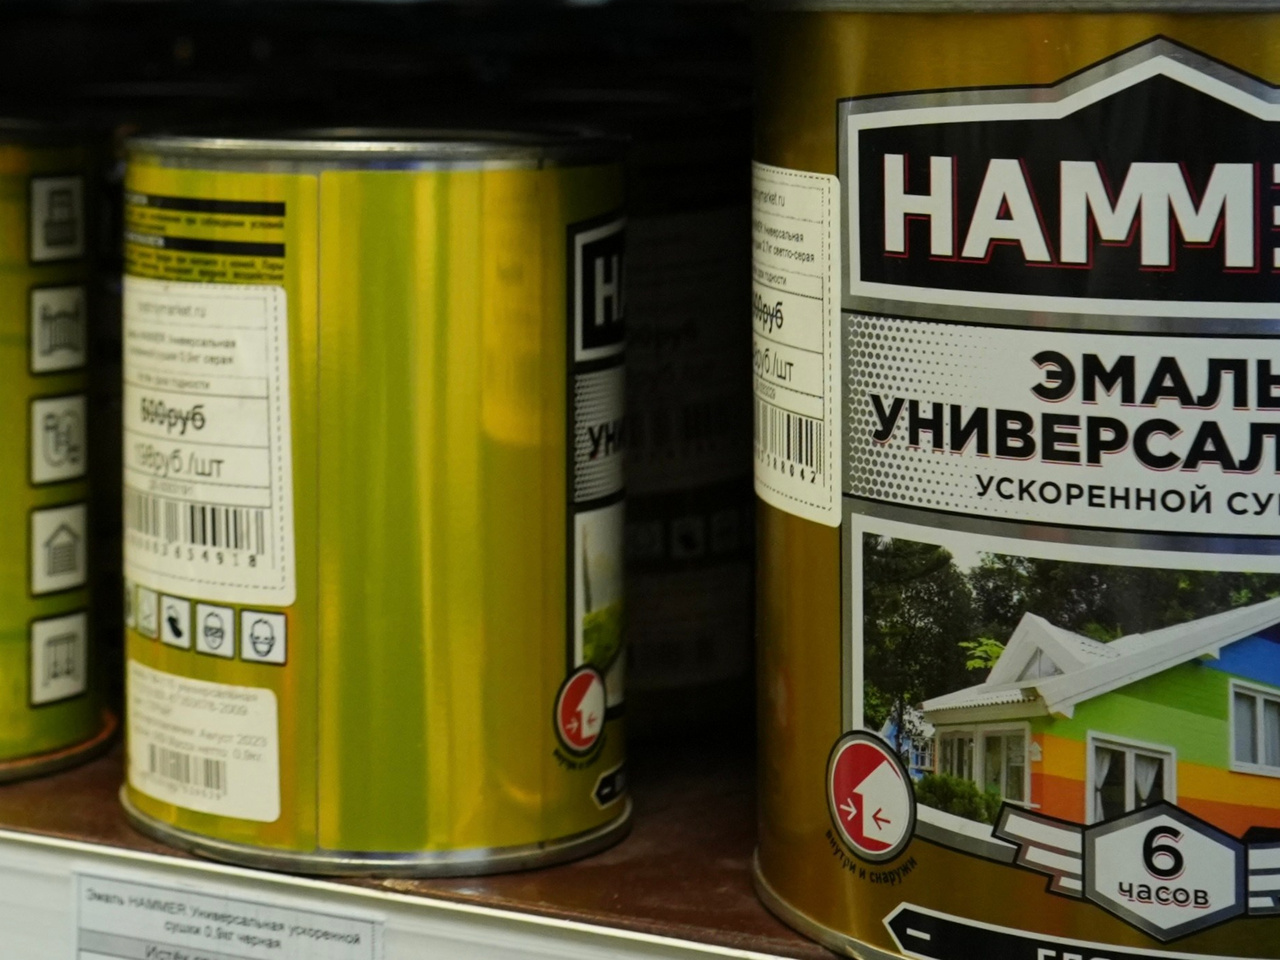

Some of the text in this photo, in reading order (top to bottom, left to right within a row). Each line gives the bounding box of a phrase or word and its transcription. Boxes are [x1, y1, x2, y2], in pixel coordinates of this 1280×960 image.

[883, 152, 1280, 274] HAMM
[975, 472, 1280, 517] УСКОРЕННОЙ СУ
[825, 828, 919, 887] внутри и снаружи
[1141, 824, 1186, 880] 6
[85, 888, 363, 947] Эмаль HAMMER Универсальная ускоренной
[1117, 880, 1212, 909] часов
[163, 919, 202, 938] сушки
[235, 932, 282, 951] черная
